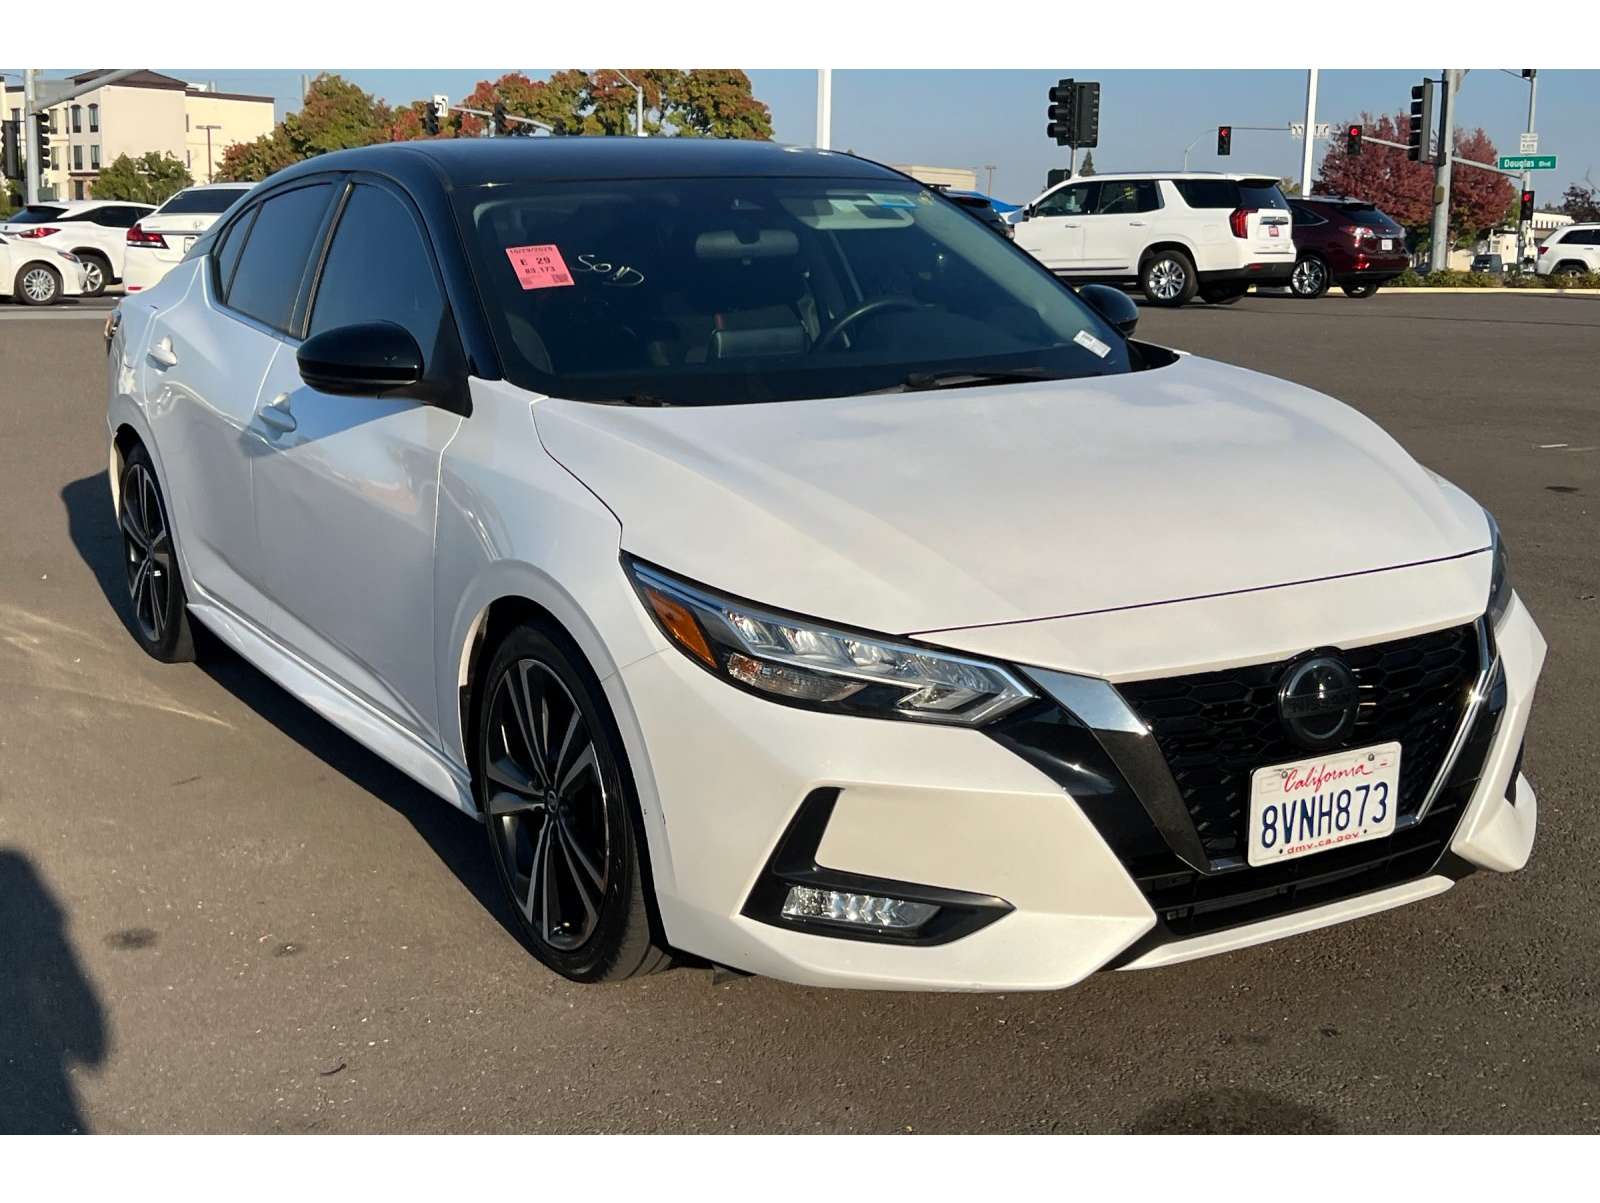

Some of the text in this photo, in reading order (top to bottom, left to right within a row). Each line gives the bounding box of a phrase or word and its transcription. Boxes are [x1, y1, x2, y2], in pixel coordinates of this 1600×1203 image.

[1504, 159, 1535, 168] Douglas
[536, 256, 551, 265] 29
[1284, 763, 1373, 793] California
[1261, 781, 1389, 849] 8VNH873
[1286, 829, 1361, 855] dmv.ca.gov
